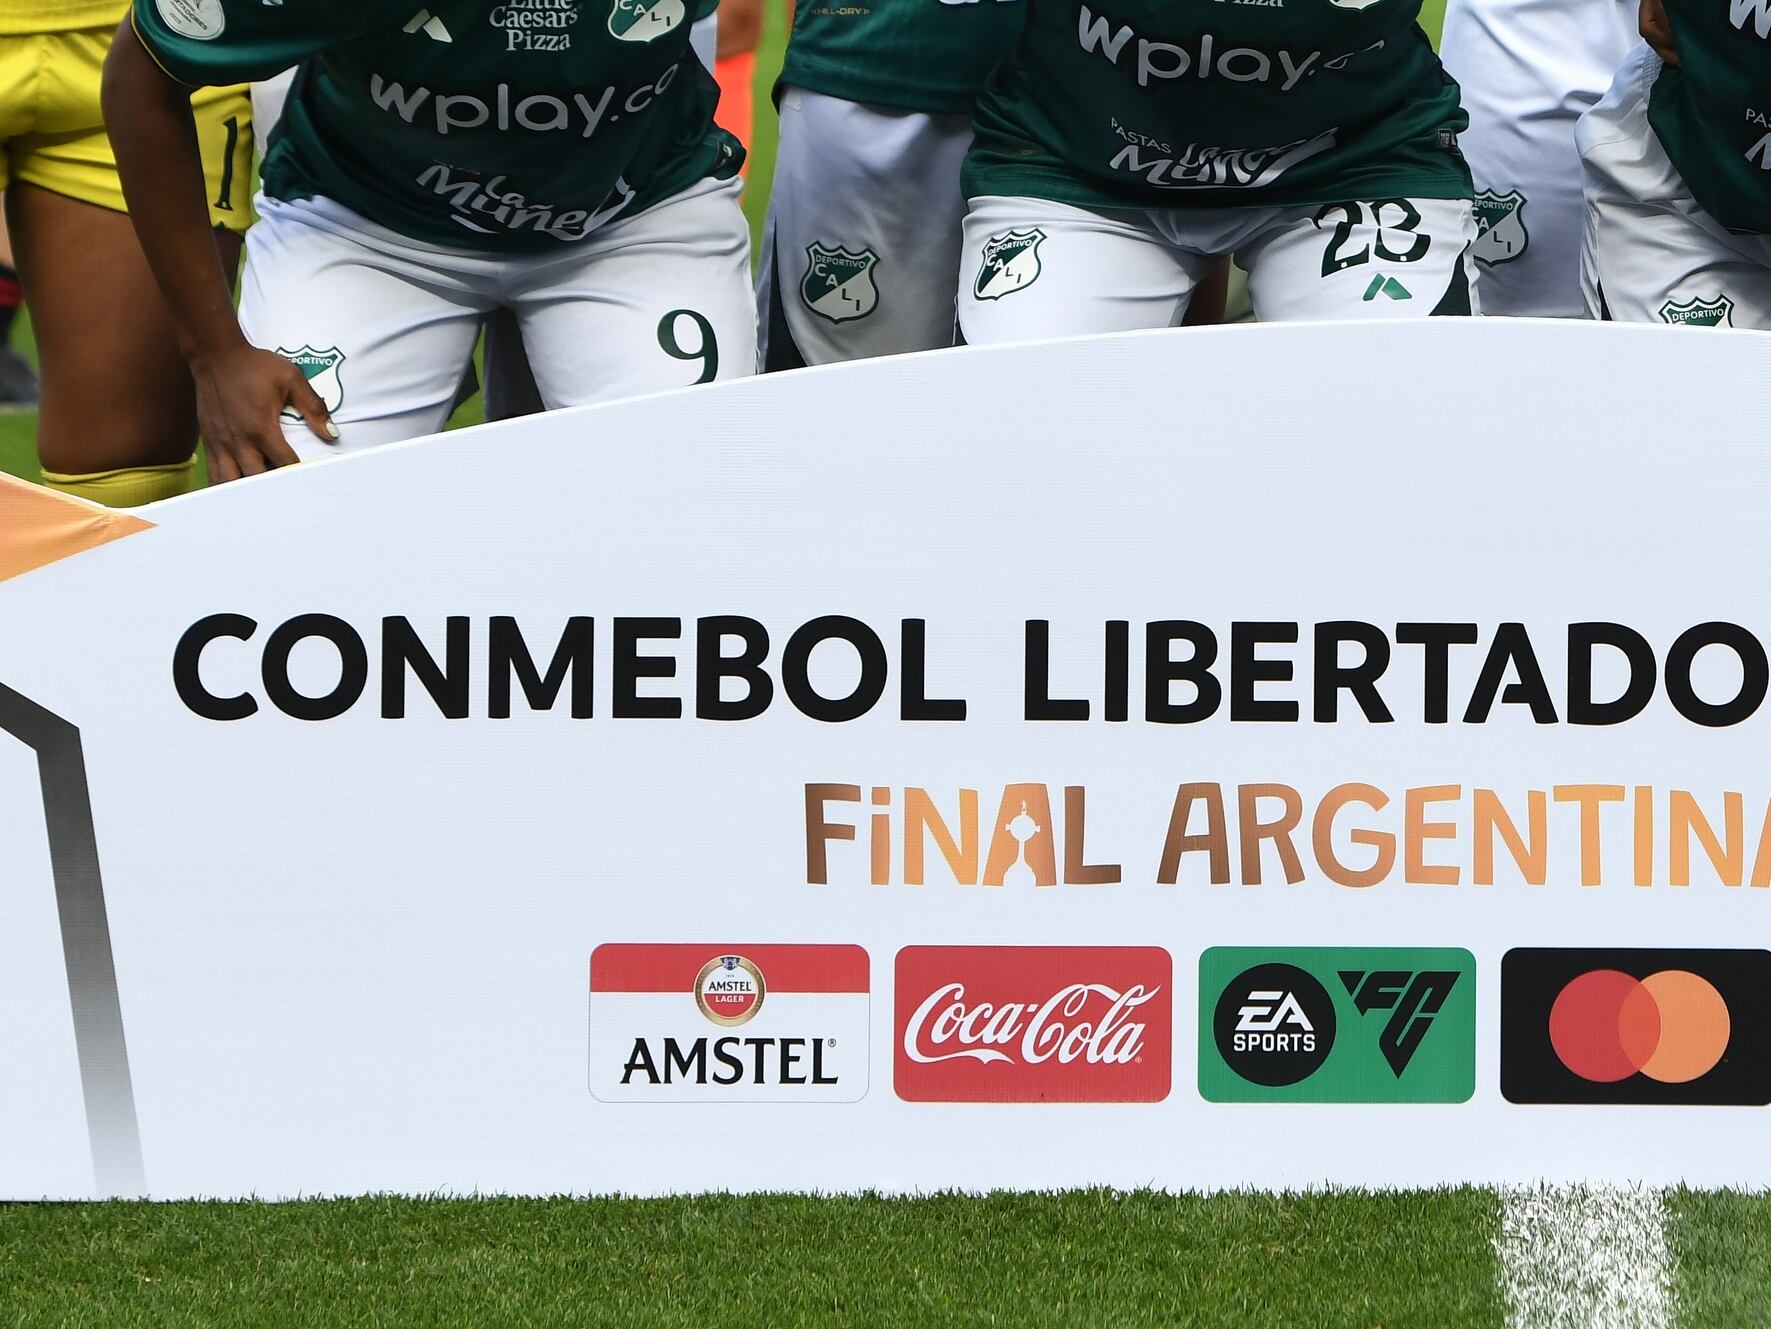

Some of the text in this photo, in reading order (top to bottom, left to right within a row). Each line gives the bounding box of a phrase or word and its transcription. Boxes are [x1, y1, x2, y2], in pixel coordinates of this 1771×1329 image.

[488, 5, 578, 29] Caesars
[505, 29, 572, 52] Pizza
[1110, 116, 1172, 154] PASTAS
[987, 238, 1032, 256] DEPORTIVO
[816, 255, 866, 269] DEPORTIVO
[986, 254, 1022, 284] CALI
[814, 263, 860, 312] CALI
[1672, 308, 1725, 322] DEPORTIVO
[656, 310, 719, 386] 9
[172, 612, 968, 723] CONMEBOL
[708, 980, 752, 992] AMSTEL
[715, 995, 745, 1004] LAGER
[904, 982, 1162, 1066] Coca-Cola
[1234, 990, 1315, 1032] EA
[1233, 1032, 1317, 1053] SPORTS
[619, 1036, 839, 1086] AMSTEL
